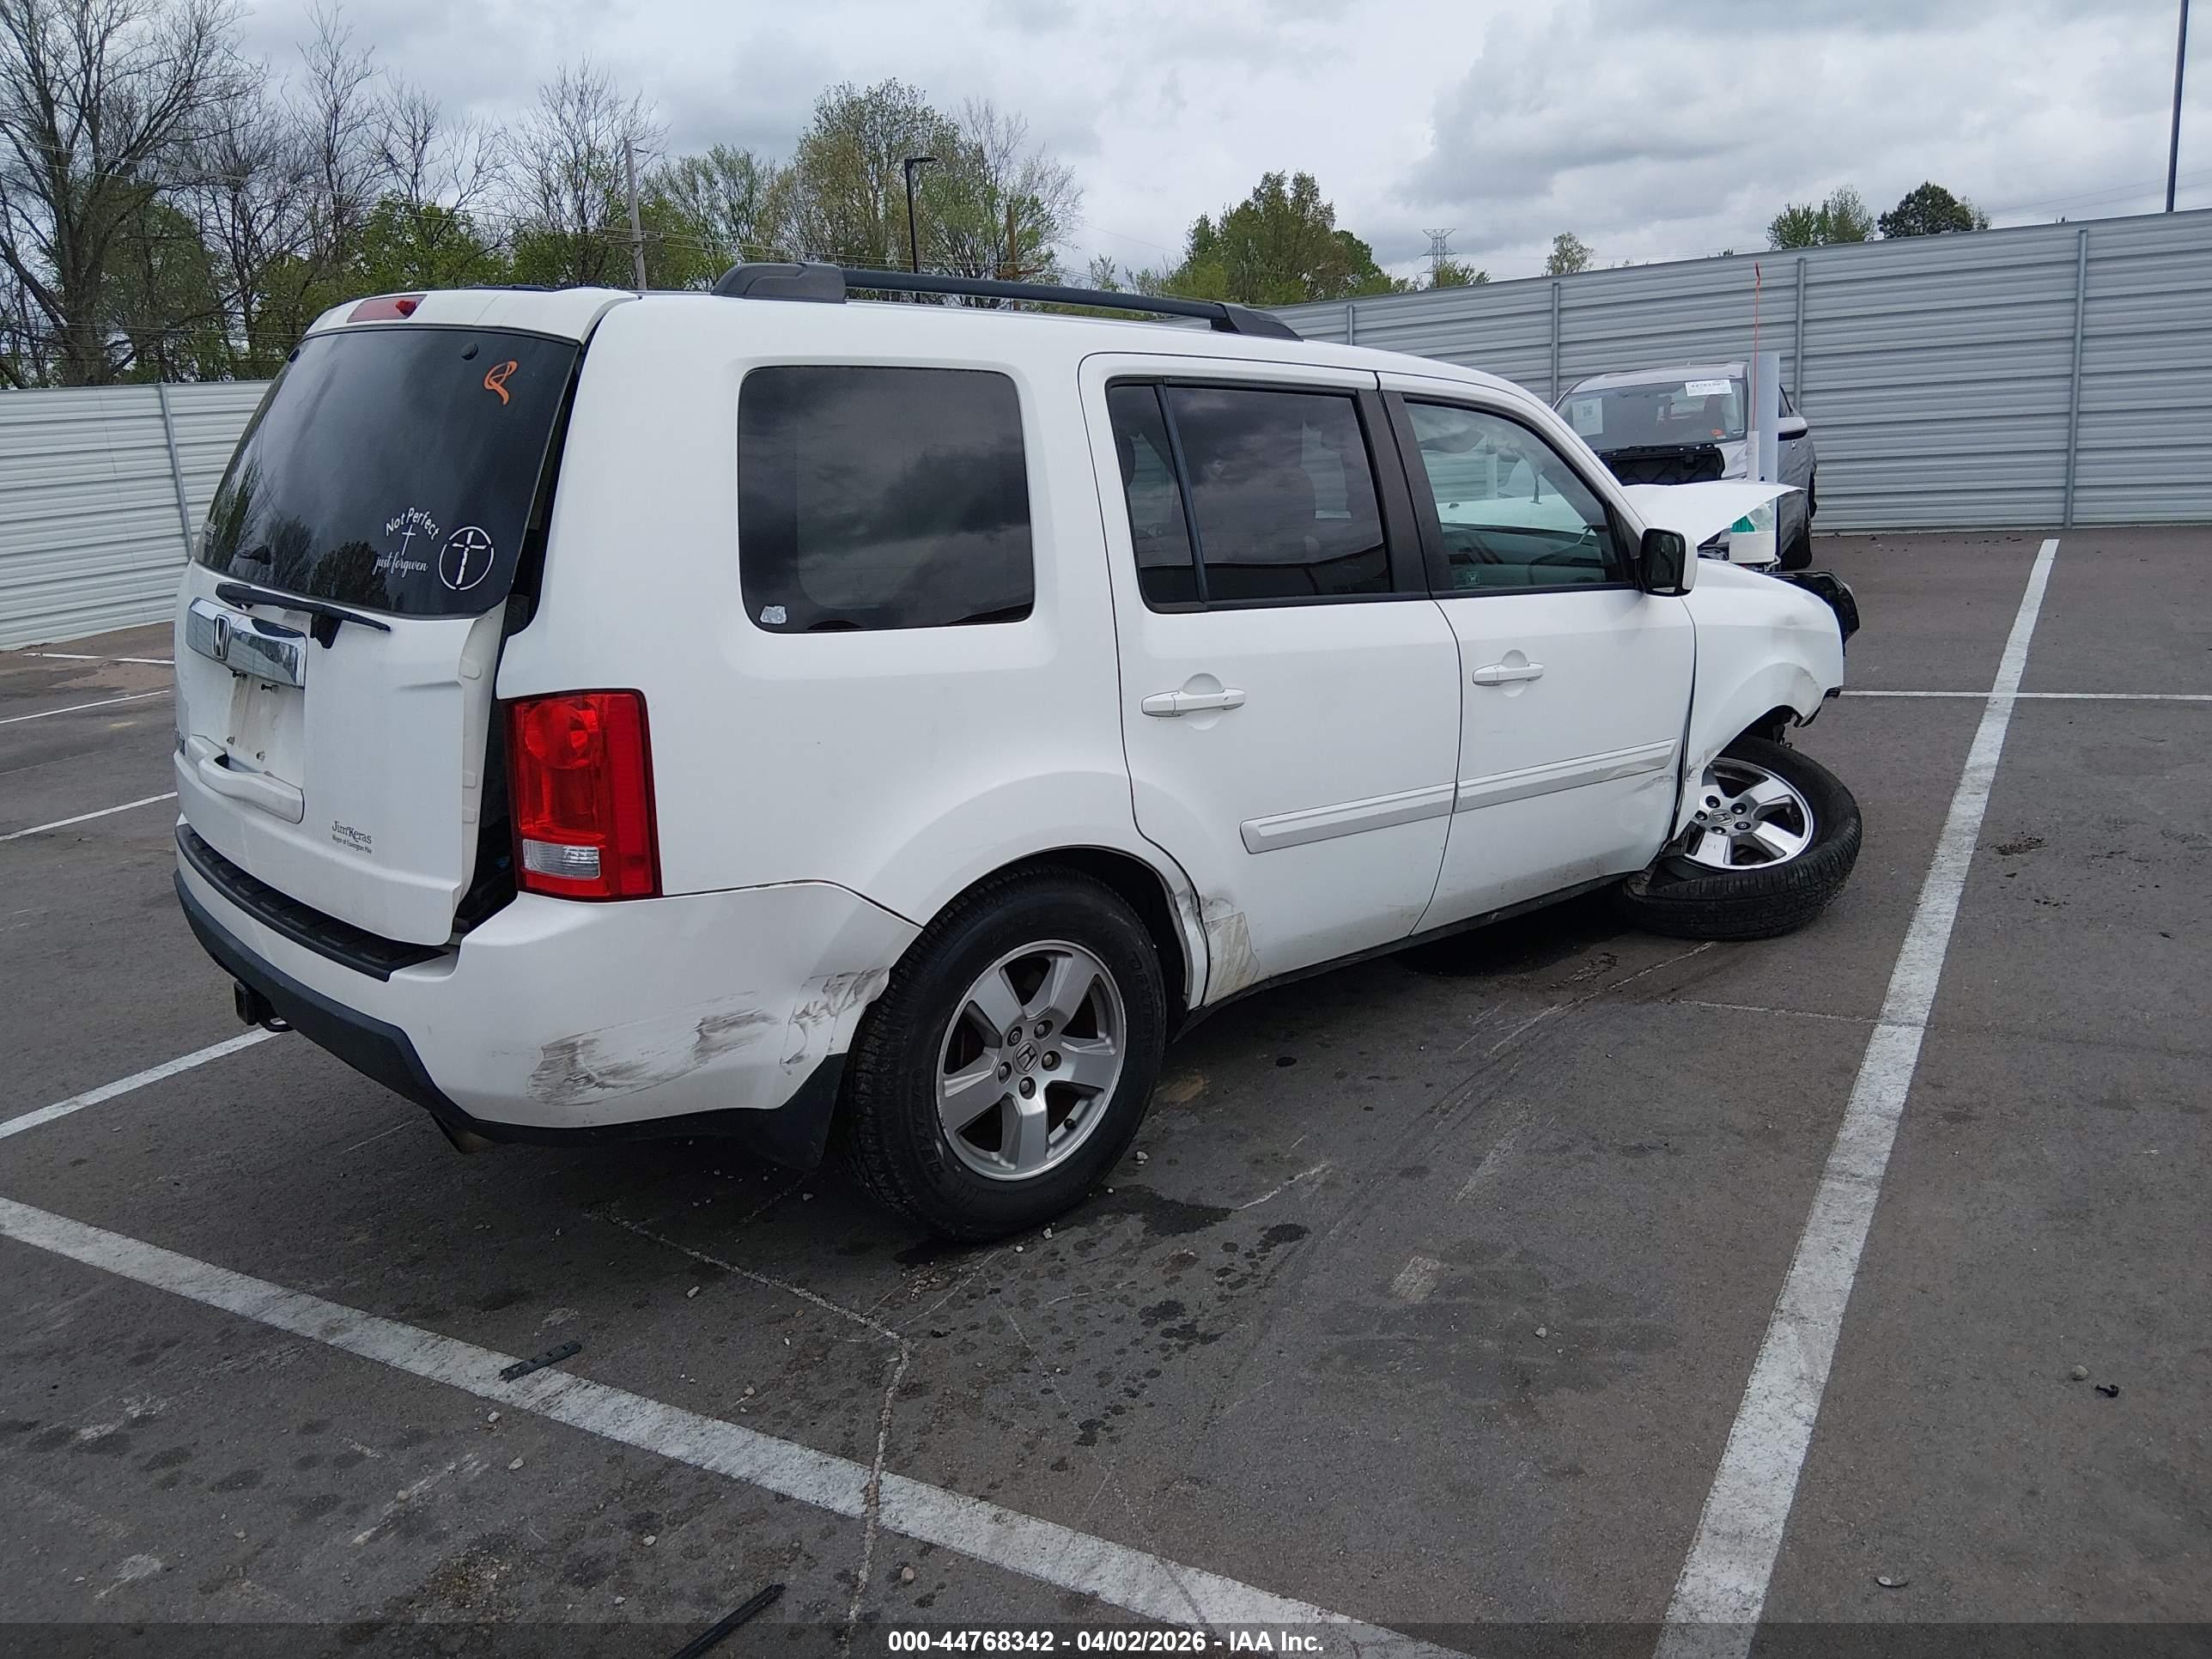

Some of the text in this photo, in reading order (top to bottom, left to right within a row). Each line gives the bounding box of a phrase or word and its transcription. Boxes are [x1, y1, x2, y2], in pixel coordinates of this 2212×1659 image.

[386, 505, 440, 540] Not Perfect
[372, 551, 393, 575] just
